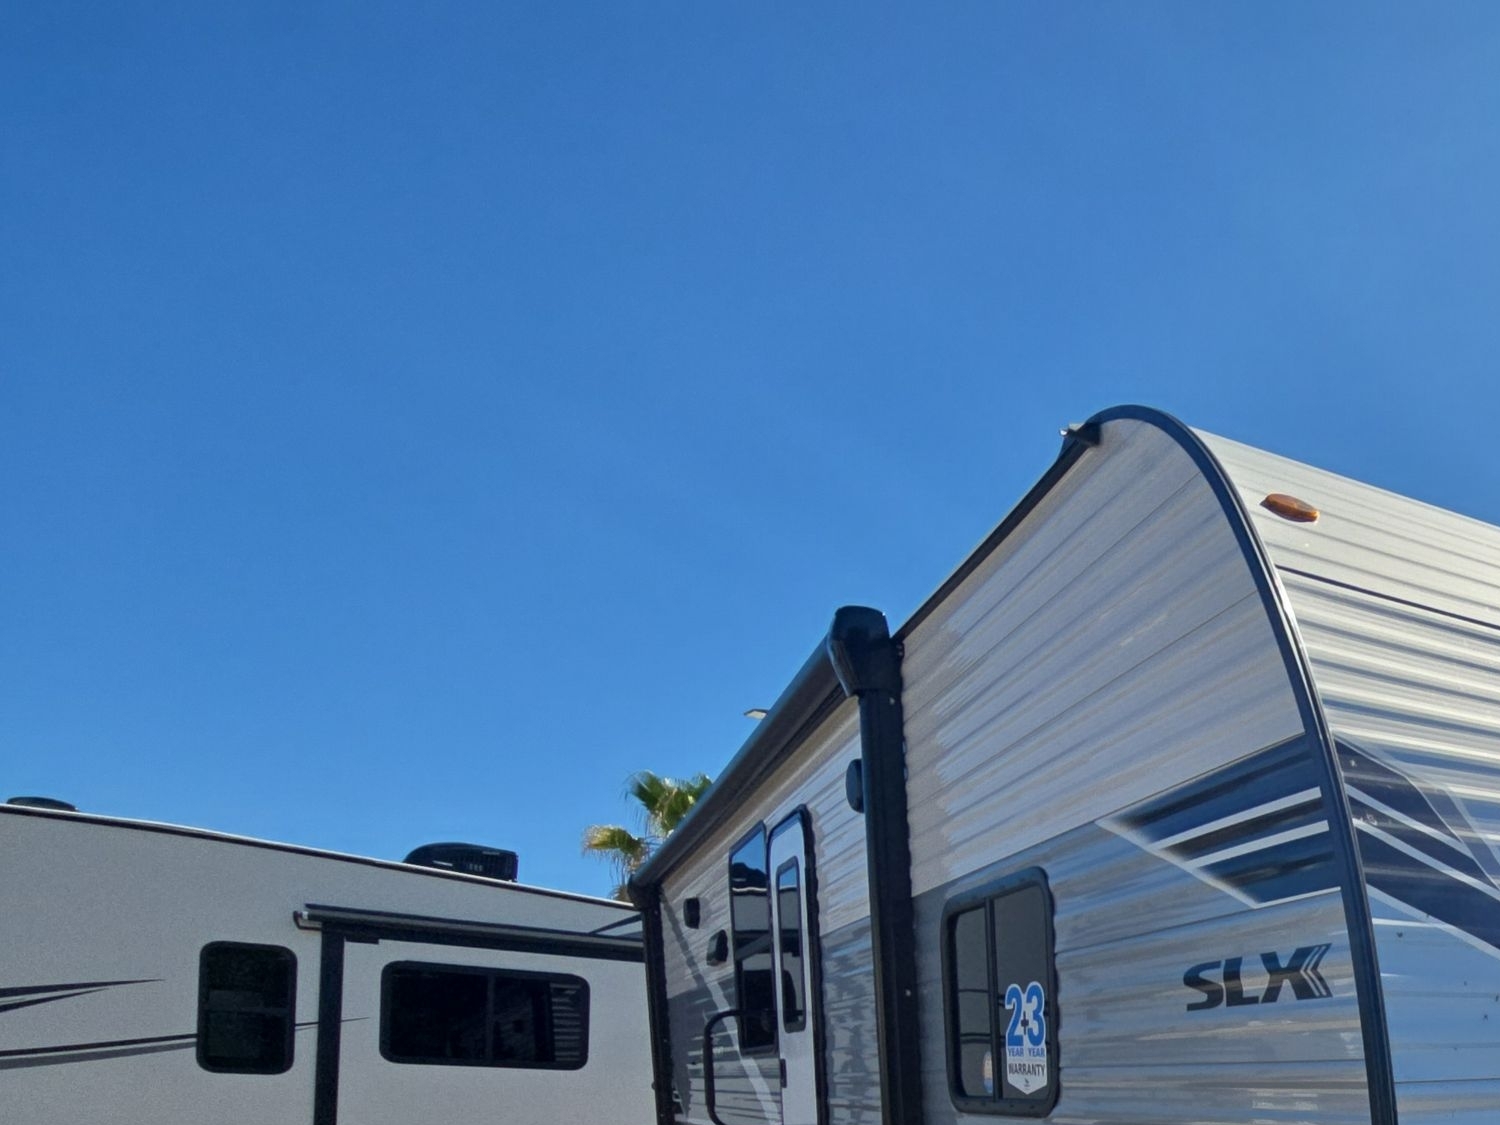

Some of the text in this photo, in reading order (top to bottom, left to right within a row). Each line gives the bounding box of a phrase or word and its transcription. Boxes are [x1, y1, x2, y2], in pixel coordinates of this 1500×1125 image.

[1183, 943, 1332, 1011] SLX
[1007, 1047, 1045, 1057] YEAR YEAR
[1008, 1063, 1046, 1077] WARRANTY
